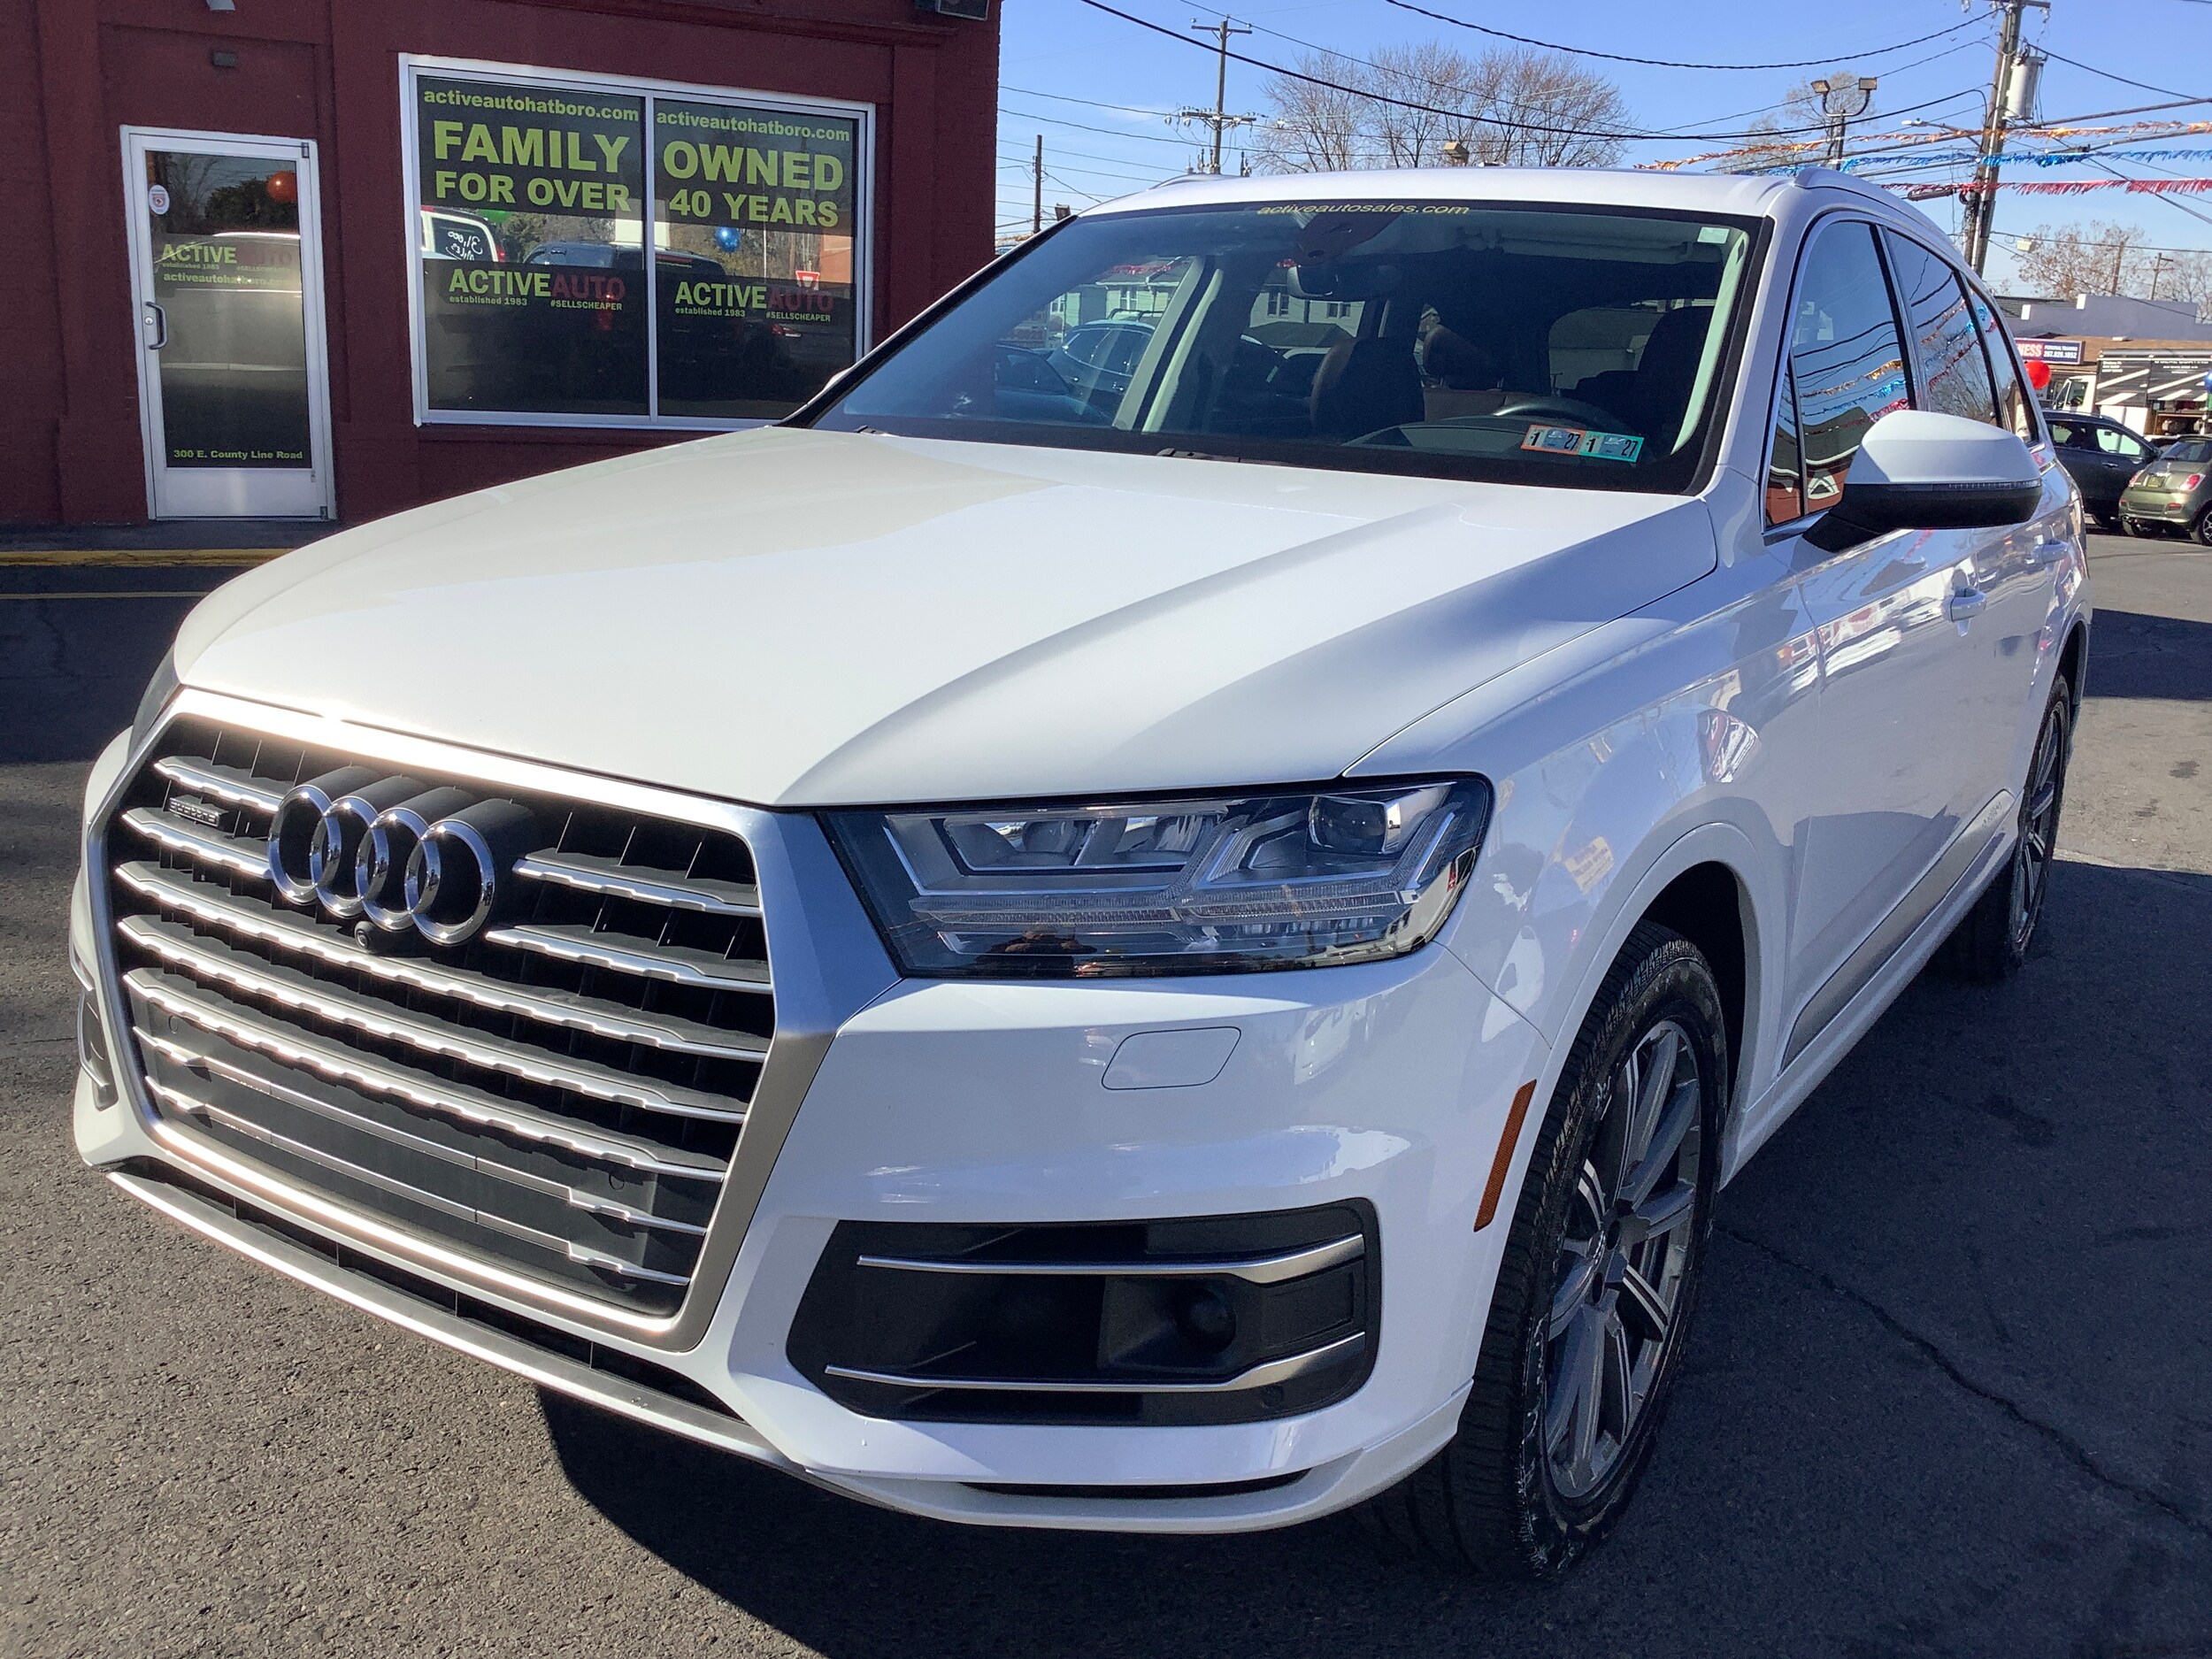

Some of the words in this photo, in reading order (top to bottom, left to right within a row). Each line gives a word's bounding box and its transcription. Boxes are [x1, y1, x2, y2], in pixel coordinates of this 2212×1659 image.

[424, 89, 640, 121] activeautohatboro.com
[657, 111, 850, 142] activeautohatboro.com
[434, 119, 630, 173] FAMILY
[664, 140, 843, 191] OWNED
[435, 170, 516, 204] FOR
[527, 177, 632, 212] OVER
[669, 188, 711, 218] 40
[722, 192, 839, 227] YEARS
[1256, 203, 1471, 214] activeautosales.com
[163, 273, 290, 286] activeautohatboro.c
[449, 295, 502, 305] established
[503, 296, 527, 306] 1983
[550, 299, 623, 311] #SELLSCHEAPER
[675, 306, 723, 316] established
[724, 308, 746, 318] 1983
[766, 311, 831, 322] #SELLSCHEAPER
[1563, 433, 1580, 450] 27
[1621, 439, 1639, 457] 27
[173, 449, 195, 458] 300
[197, 449, 207, 458] E.
[211, 449, 248, 461] County
[251, 450, 273, 459] Line
[276, 450, 303, 459] Road
